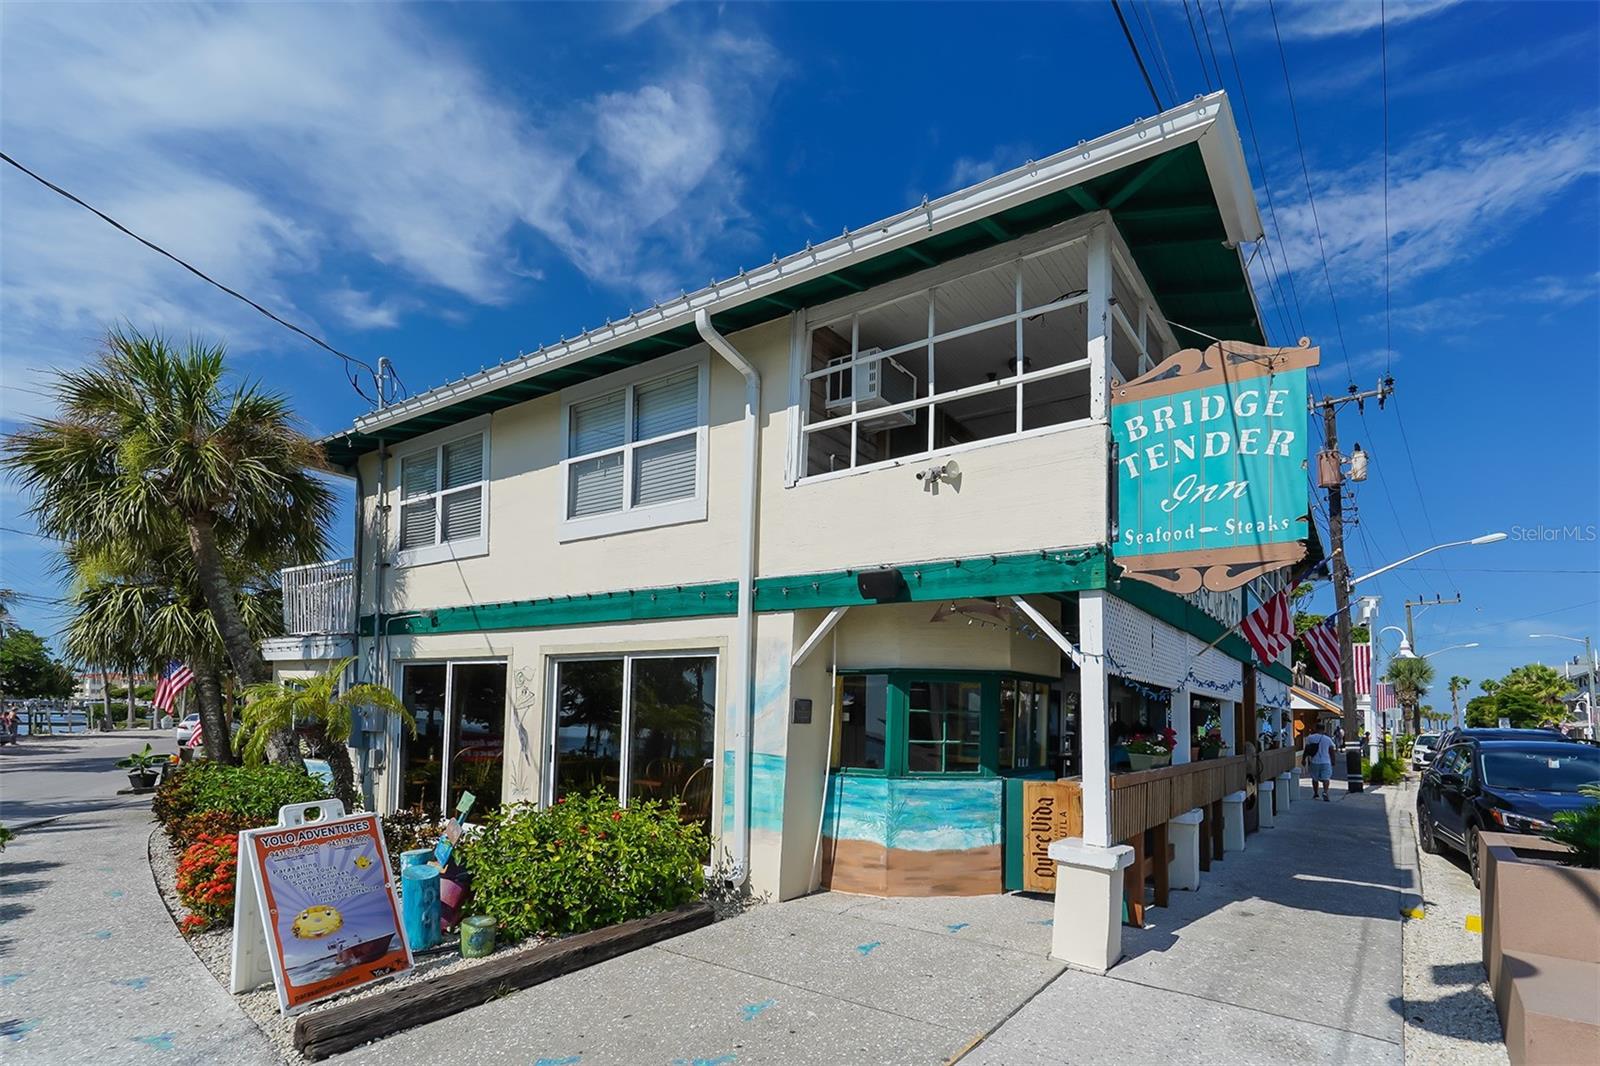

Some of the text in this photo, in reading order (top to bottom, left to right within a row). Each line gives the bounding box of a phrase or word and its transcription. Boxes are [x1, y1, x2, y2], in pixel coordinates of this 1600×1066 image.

[1124, 389, 1289, 443] BRIDGE
[1119, 428, 1295, 479] TENDER
[1160, 474, 1249, 513] Inn
[1124, 515, 1290, 546] Seafood Steaks
[262, 821, 370, 847] YOLO ADVENTURES
[1031, 797, 1056, 878] Dulce Vida
[272, 862, 318, 875] Parasailing
[282, 865, 338, 881] Dolphin Tours
[292, 870, 350, 886] Sunset Cruises
[312, 887, 336, 897] Family
